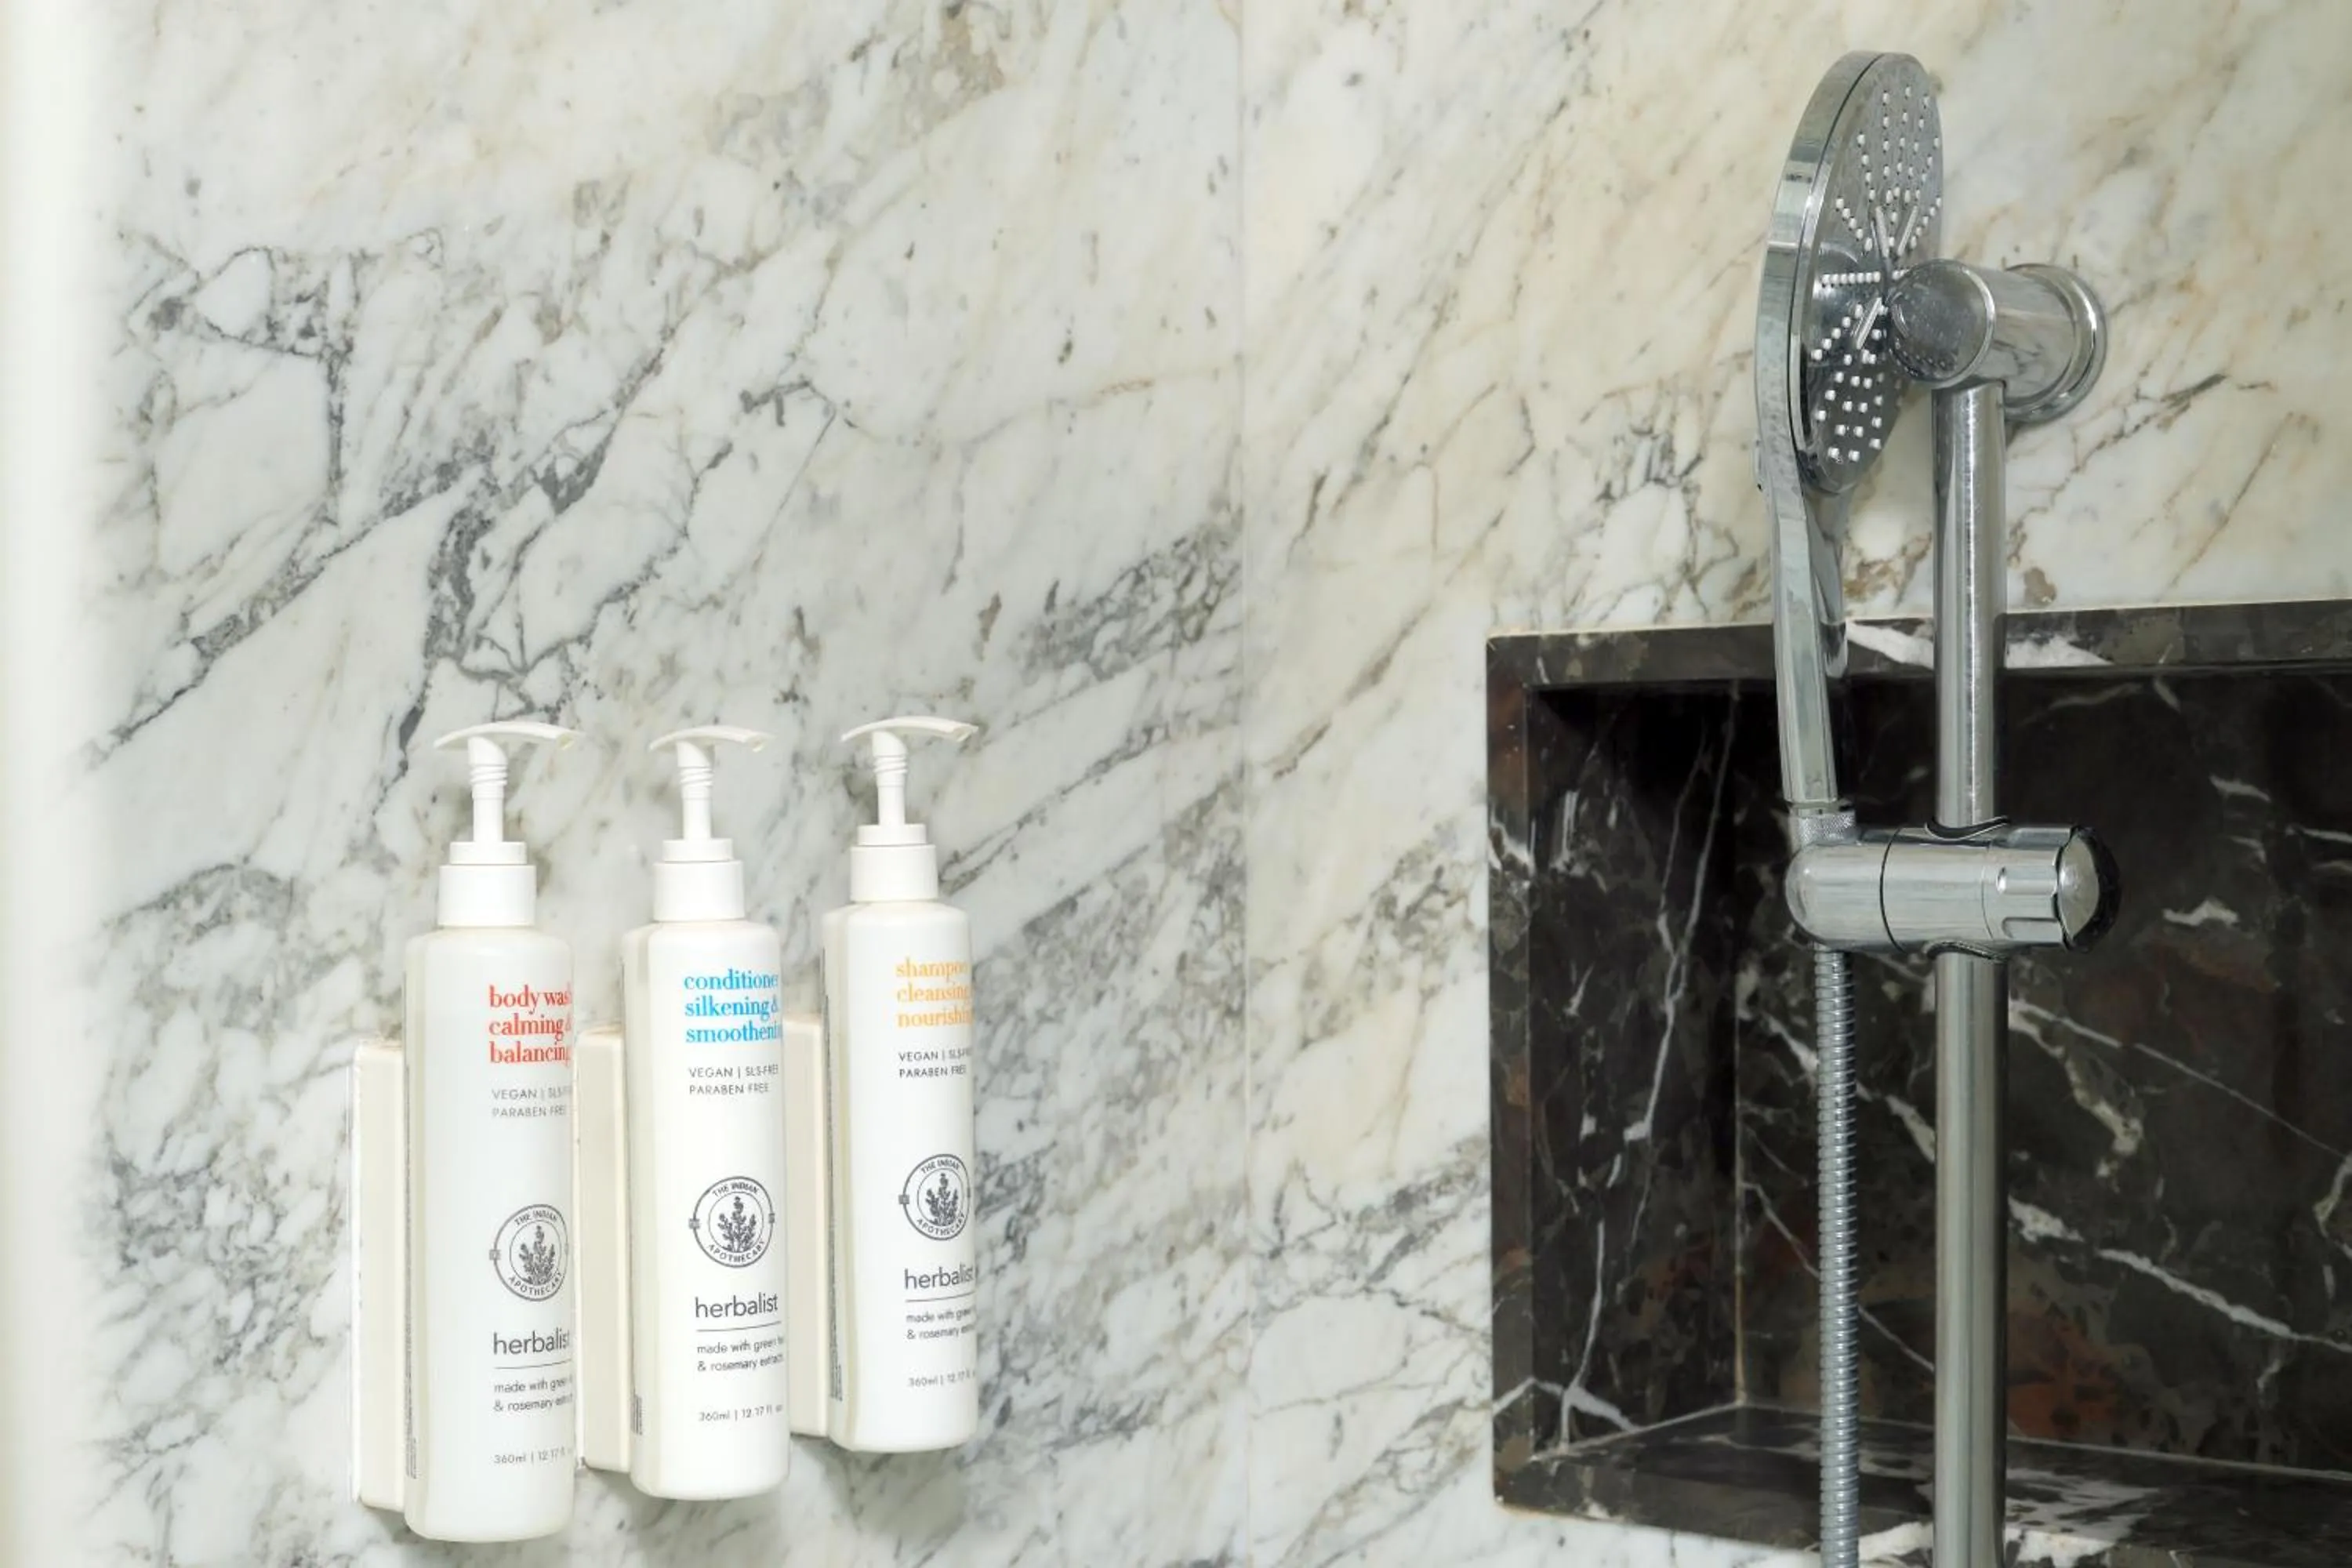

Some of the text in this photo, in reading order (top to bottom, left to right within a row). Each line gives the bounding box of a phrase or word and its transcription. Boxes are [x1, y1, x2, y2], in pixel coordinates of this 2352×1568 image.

[684, 967, 779, 990] conditione
[489, 985, 539, 1014] body
[684, 995, 770, 1021] silkening
[489, 1013, 564, 1041] calming
[898, 1051, 938, 1062] VEGAN
[688, 1067, 733, 1078] VEGAN
[899, 1067, 947, 1078] PARABEN
[492, 1087, 537, 1099] VEGAN
[689, 1083, 770, 1095] PARABEN FREE
[492, 1106, 546, 1117] PARABEN
[921, 1161, 936, 1174] THE
[712, 1182, 759, 1197] THE INDIAN
[514, 1214, 532, 1225] THE
[709, 1239, 765, 1263] APOTHECARY
[695, 1292, 778, 1318] herbalist
[906, 1311, 935, 1323] made
[937, 1308, 954, 1320] with
[906, 1330, 916, 1339] &
[919, 1327, 960, 1338] rosemary
[697, 1342, 728, 1353] made
[730, 1340, 750, 1352] with
[697, 1361, 706, 1371] &
[711, 1359, 757, 1371] rosemary
[494, 1381, 526, 1393] made
[529, 1377, 548, 1391] with
[493, 1399, 503, 1412] &
[507, 1399, 553, 1412] rosemary
[494, 1452, 526, 1464] 360ml
